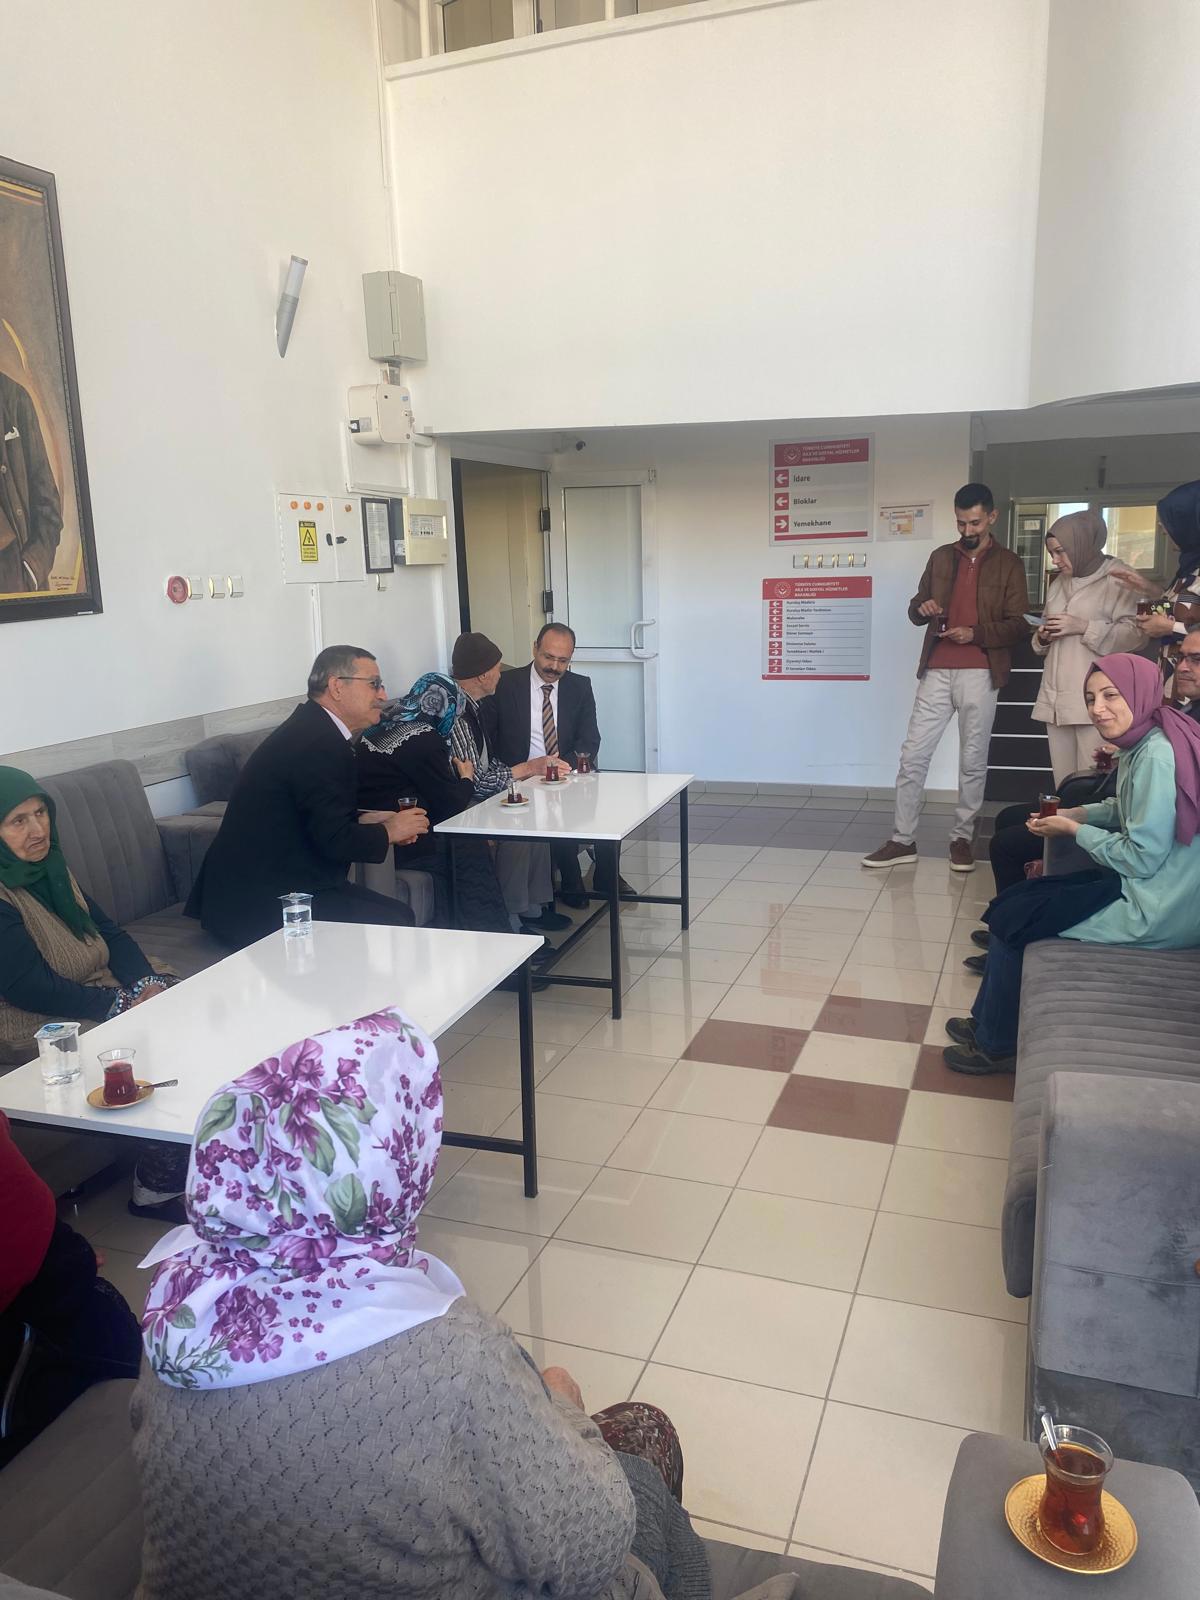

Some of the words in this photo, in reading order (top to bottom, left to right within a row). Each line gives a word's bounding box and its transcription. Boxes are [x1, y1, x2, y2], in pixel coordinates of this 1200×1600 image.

[793, 474, 811, 483] İdare
[793, 497, 817, 506] Bloklar
[793, 519, 832, 528] Yemekhane
